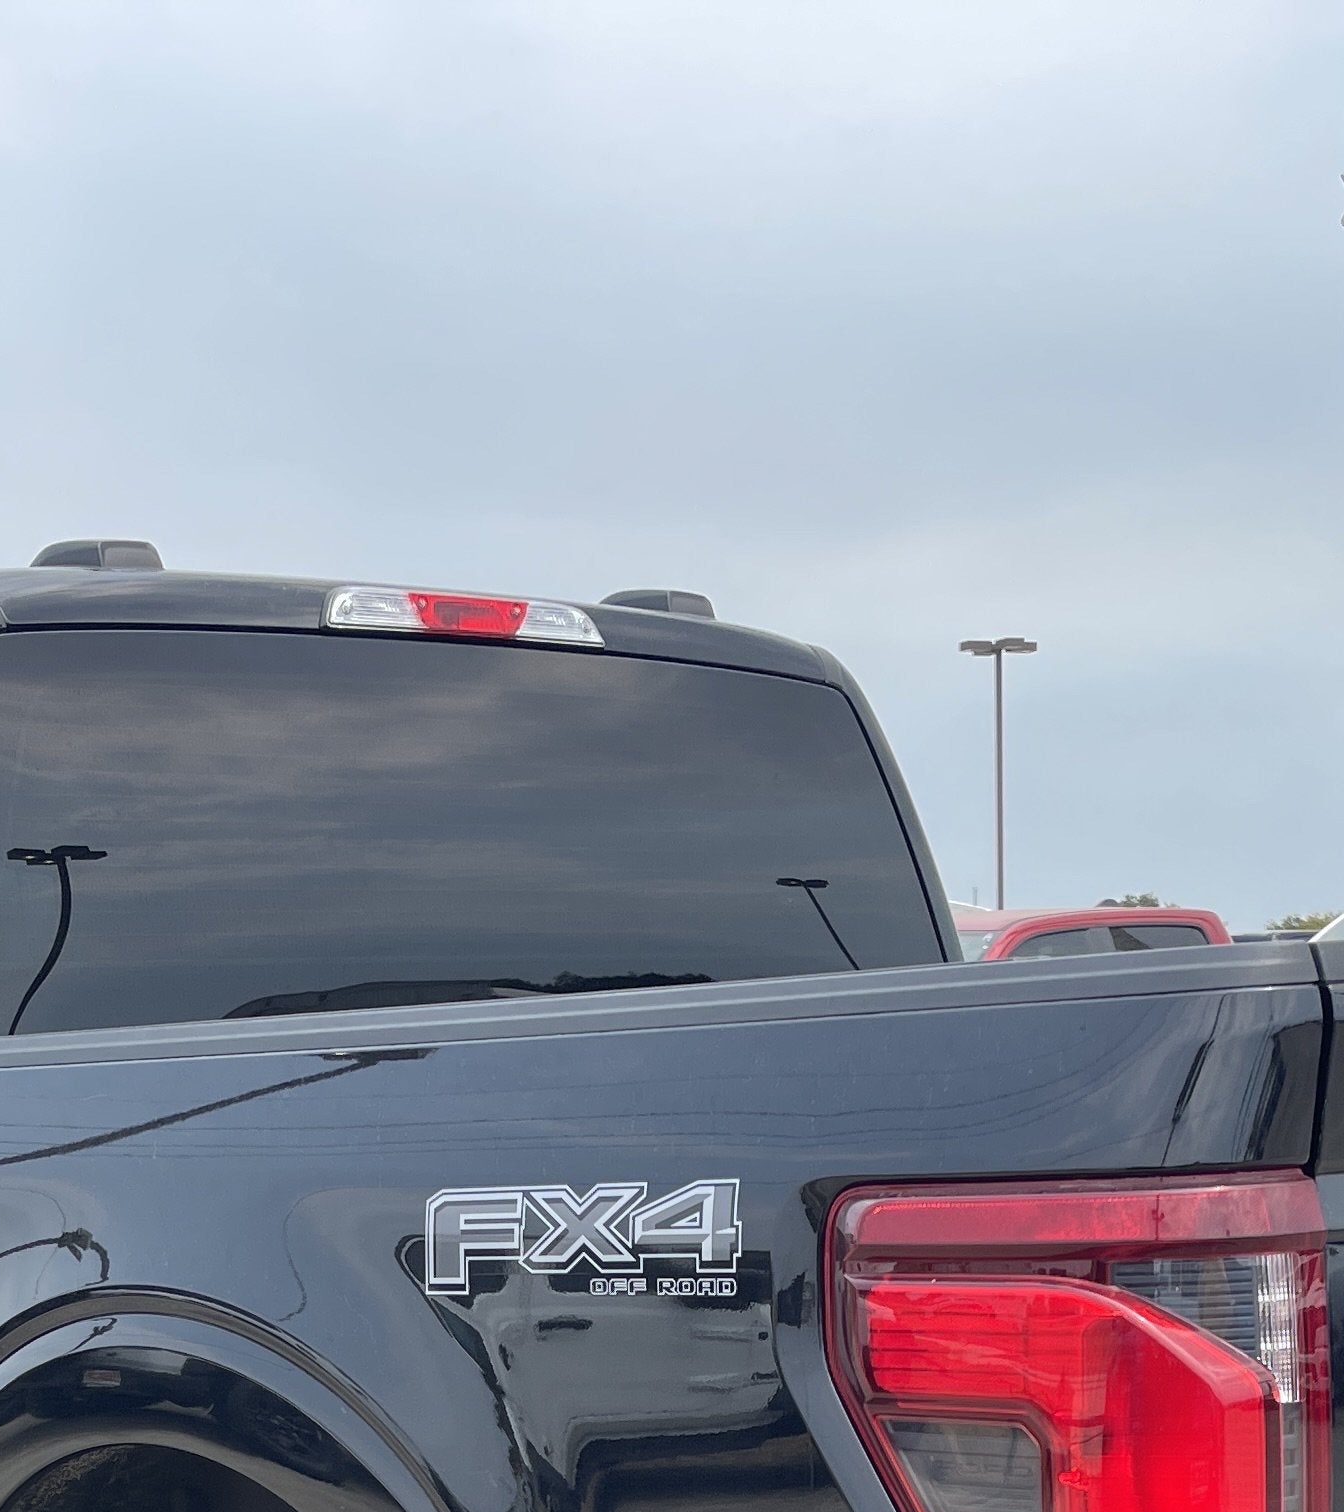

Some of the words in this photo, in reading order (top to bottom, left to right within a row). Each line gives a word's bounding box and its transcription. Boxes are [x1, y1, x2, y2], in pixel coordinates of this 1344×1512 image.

[425, 1179, 743, 1295] FX4
[589, 1278, 647, 1296] OFF
[657, 1278, 737, 1296] ROAD
